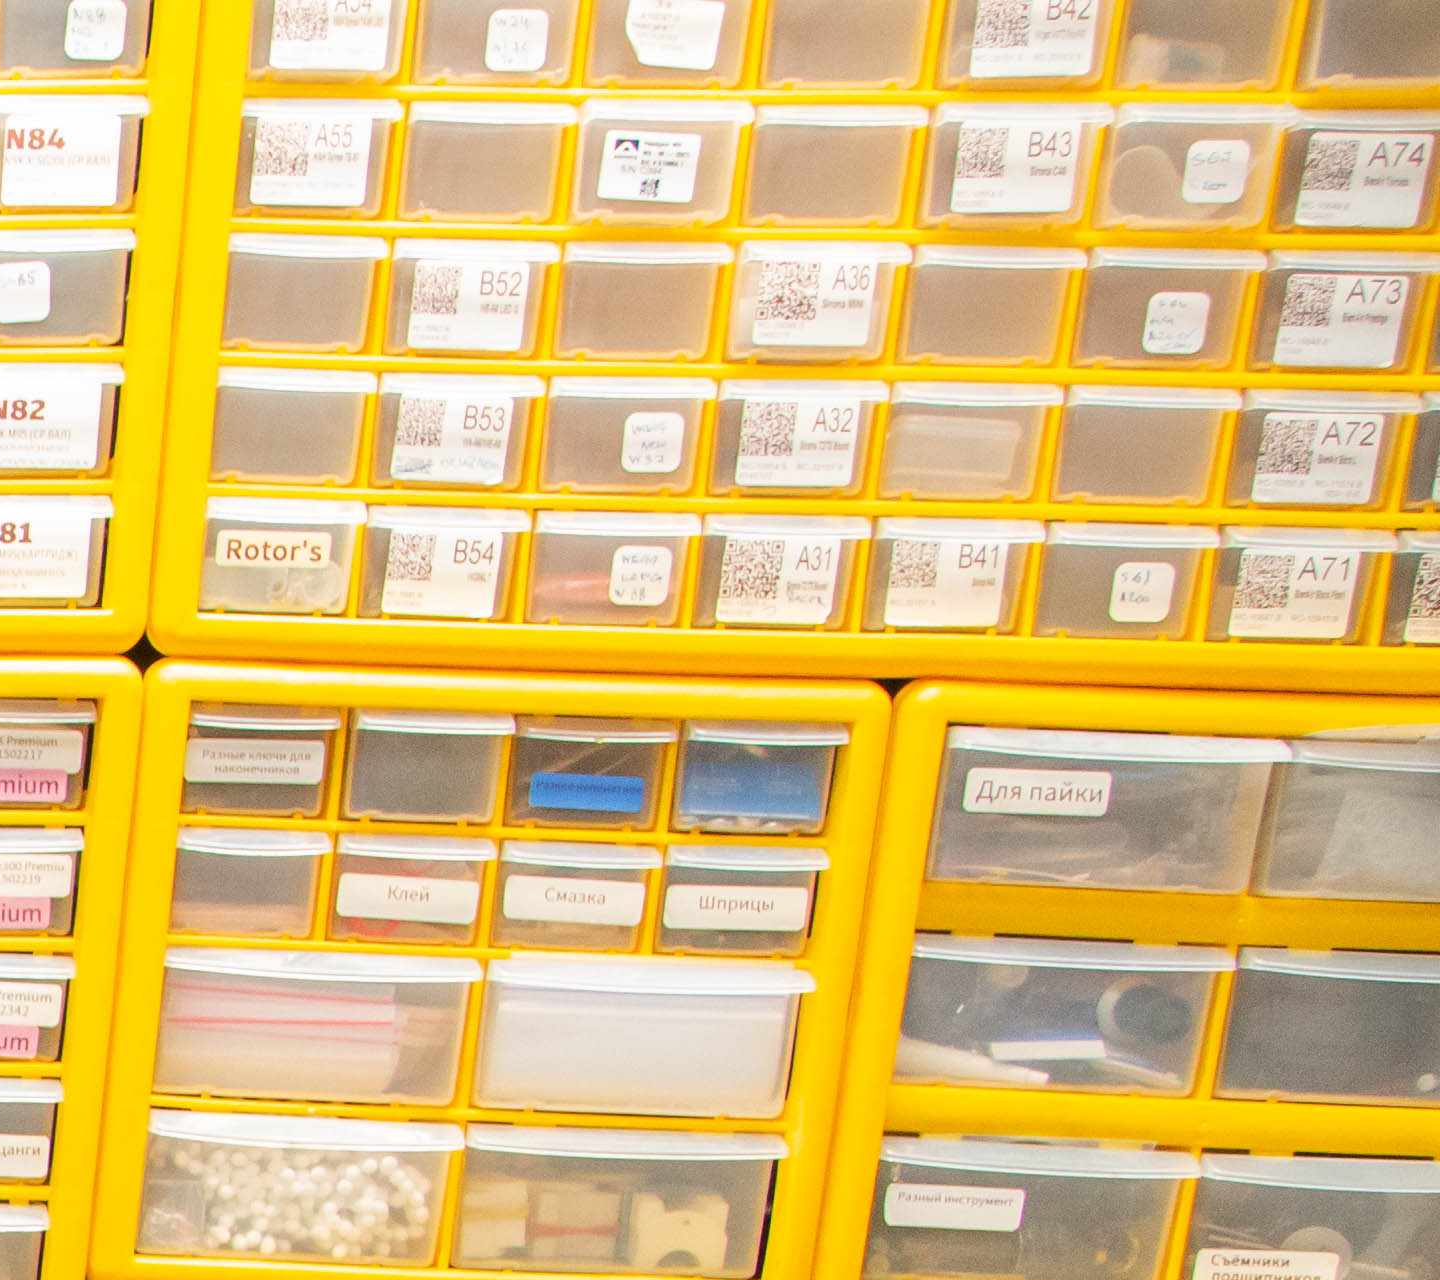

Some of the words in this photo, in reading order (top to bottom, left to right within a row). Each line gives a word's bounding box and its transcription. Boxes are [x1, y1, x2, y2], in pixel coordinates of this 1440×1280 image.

[6, 128, 65, 150] N84
[314, 123, 352, 148] A55
[1026, 131, 1072, 158] B43
[1367, 141, 1429, 171] A74
[479, 270, 522, 297] B52
[831, 265, 870, 291] A36
[1345, 279, 1406, 308] A73
[462, 404, 504, 432] B53
[811, 407, 853, 433] A32
[1320, 421, 1377, 451] A72
[226, 539, 321, 562] Rotor's
[452, 539, 494, 565] B54
[794, 545, 831, 571] A31
[957, 543, 999, 569] B41
[1296, 556, 1350, 581] A71
[974, 780, 1021, 804] Для
[1029, 782, 1103, 804] пайки
[387, 885, 429, 902] Клей
[544, 887, 605, 904] Смазка
[698, 895, 774, 914] Шприцы
